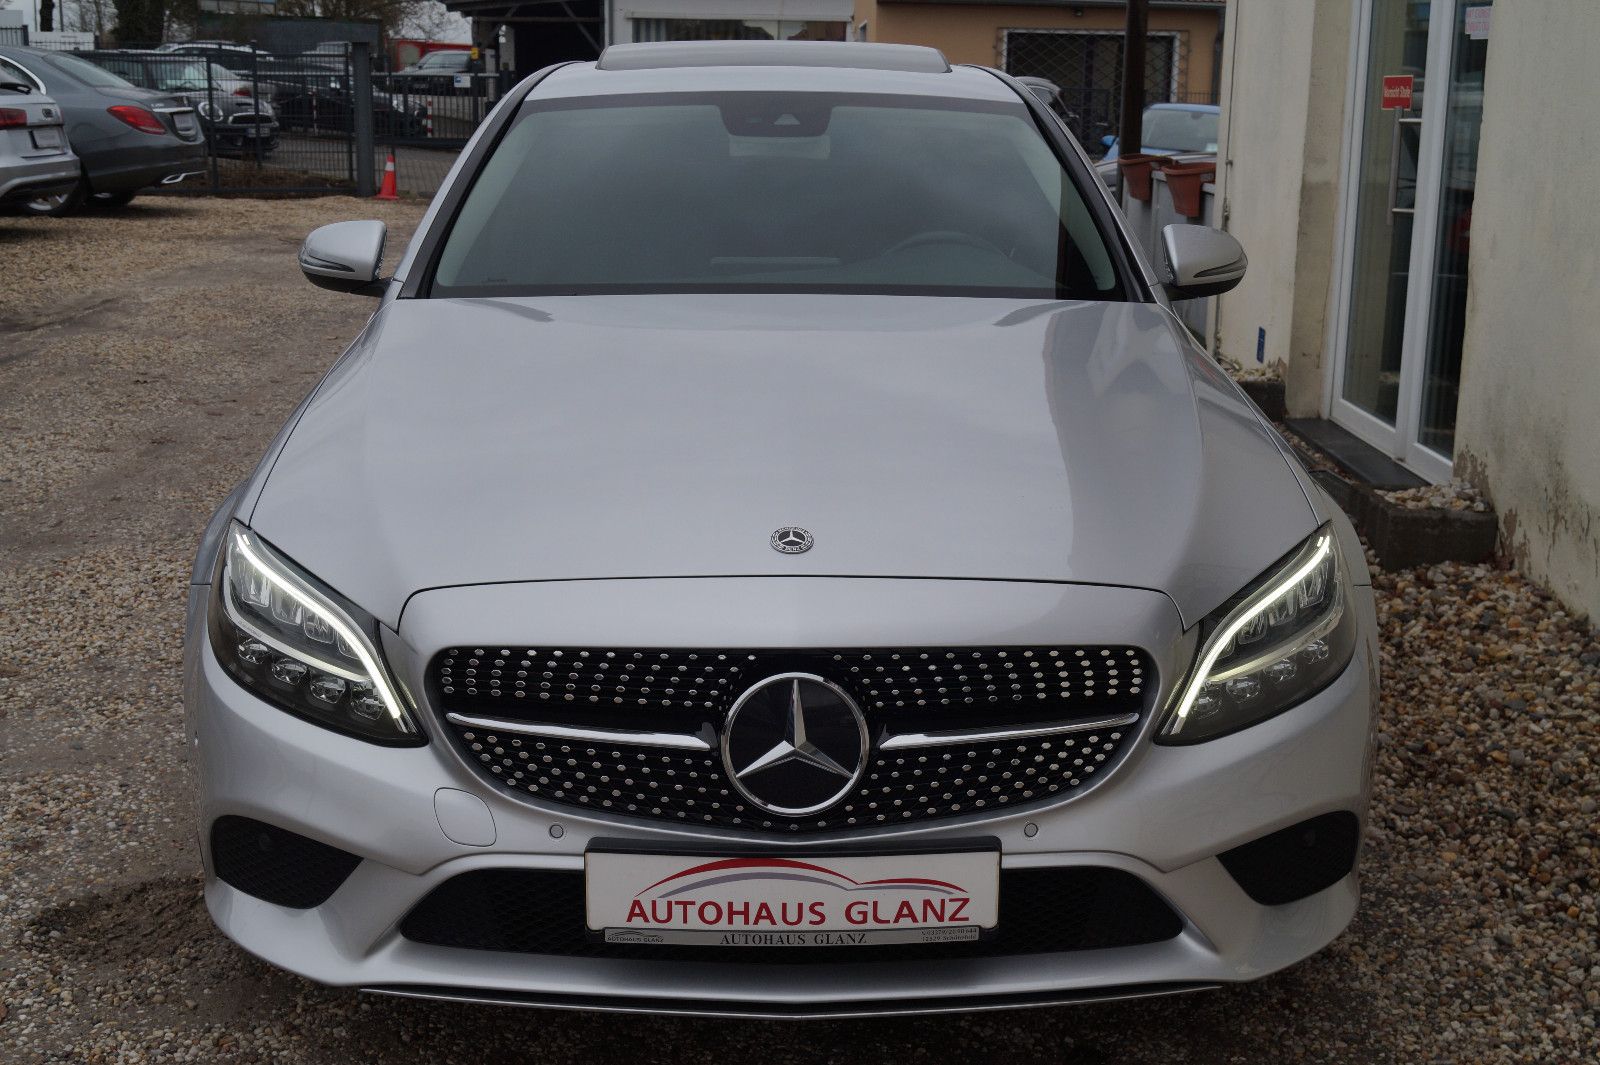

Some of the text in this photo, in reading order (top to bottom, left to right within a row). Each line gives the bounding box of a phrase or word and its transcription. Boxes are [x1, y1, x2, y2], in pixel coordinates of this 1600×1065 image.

[626, 898, 970, 925] AUTOHAUS GLANZ
[720, 933, 867, 945] AUTOHAUS GLANZ
